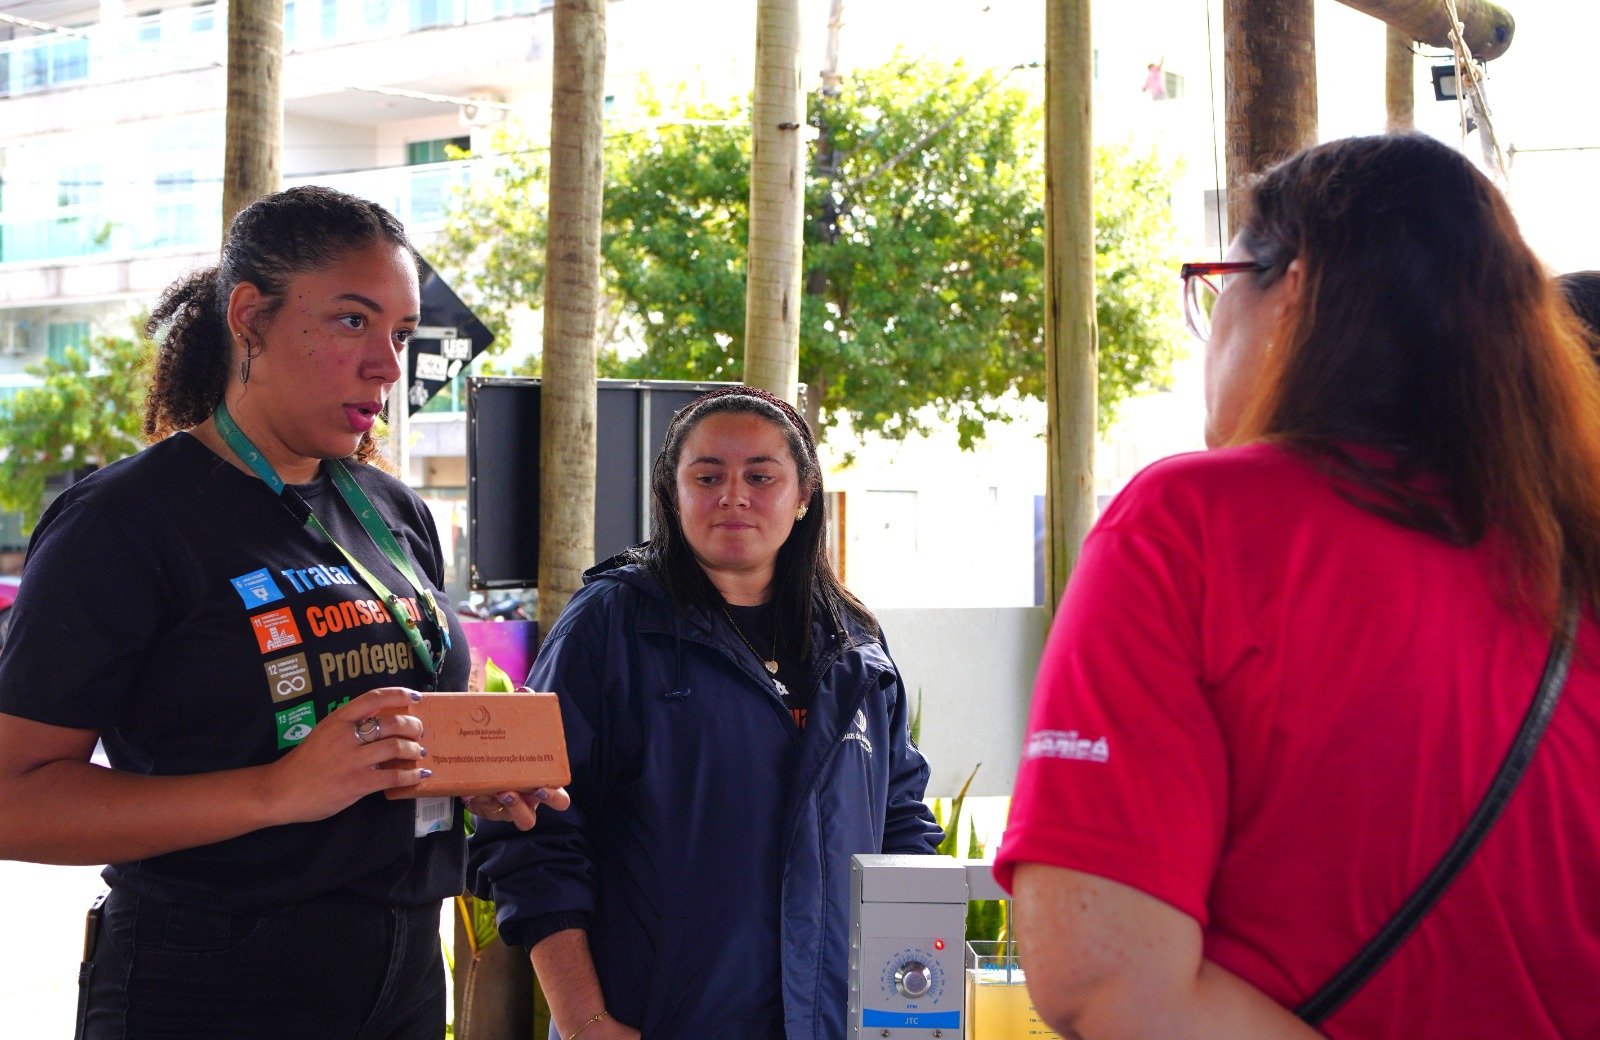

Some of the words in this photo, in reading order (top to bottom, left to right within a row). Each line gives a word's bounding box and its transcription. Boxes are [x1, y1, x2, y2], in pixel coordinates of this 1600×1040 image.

[281, 564, 358, 593] Tratar
[253, 618, 262, 628] 11
[319, 641, 414, 687] Proteger
[267, 664, 278, 676] 12
[277, 714, 287, 725] 13
[904, 1017, 919, 1025] JTC
